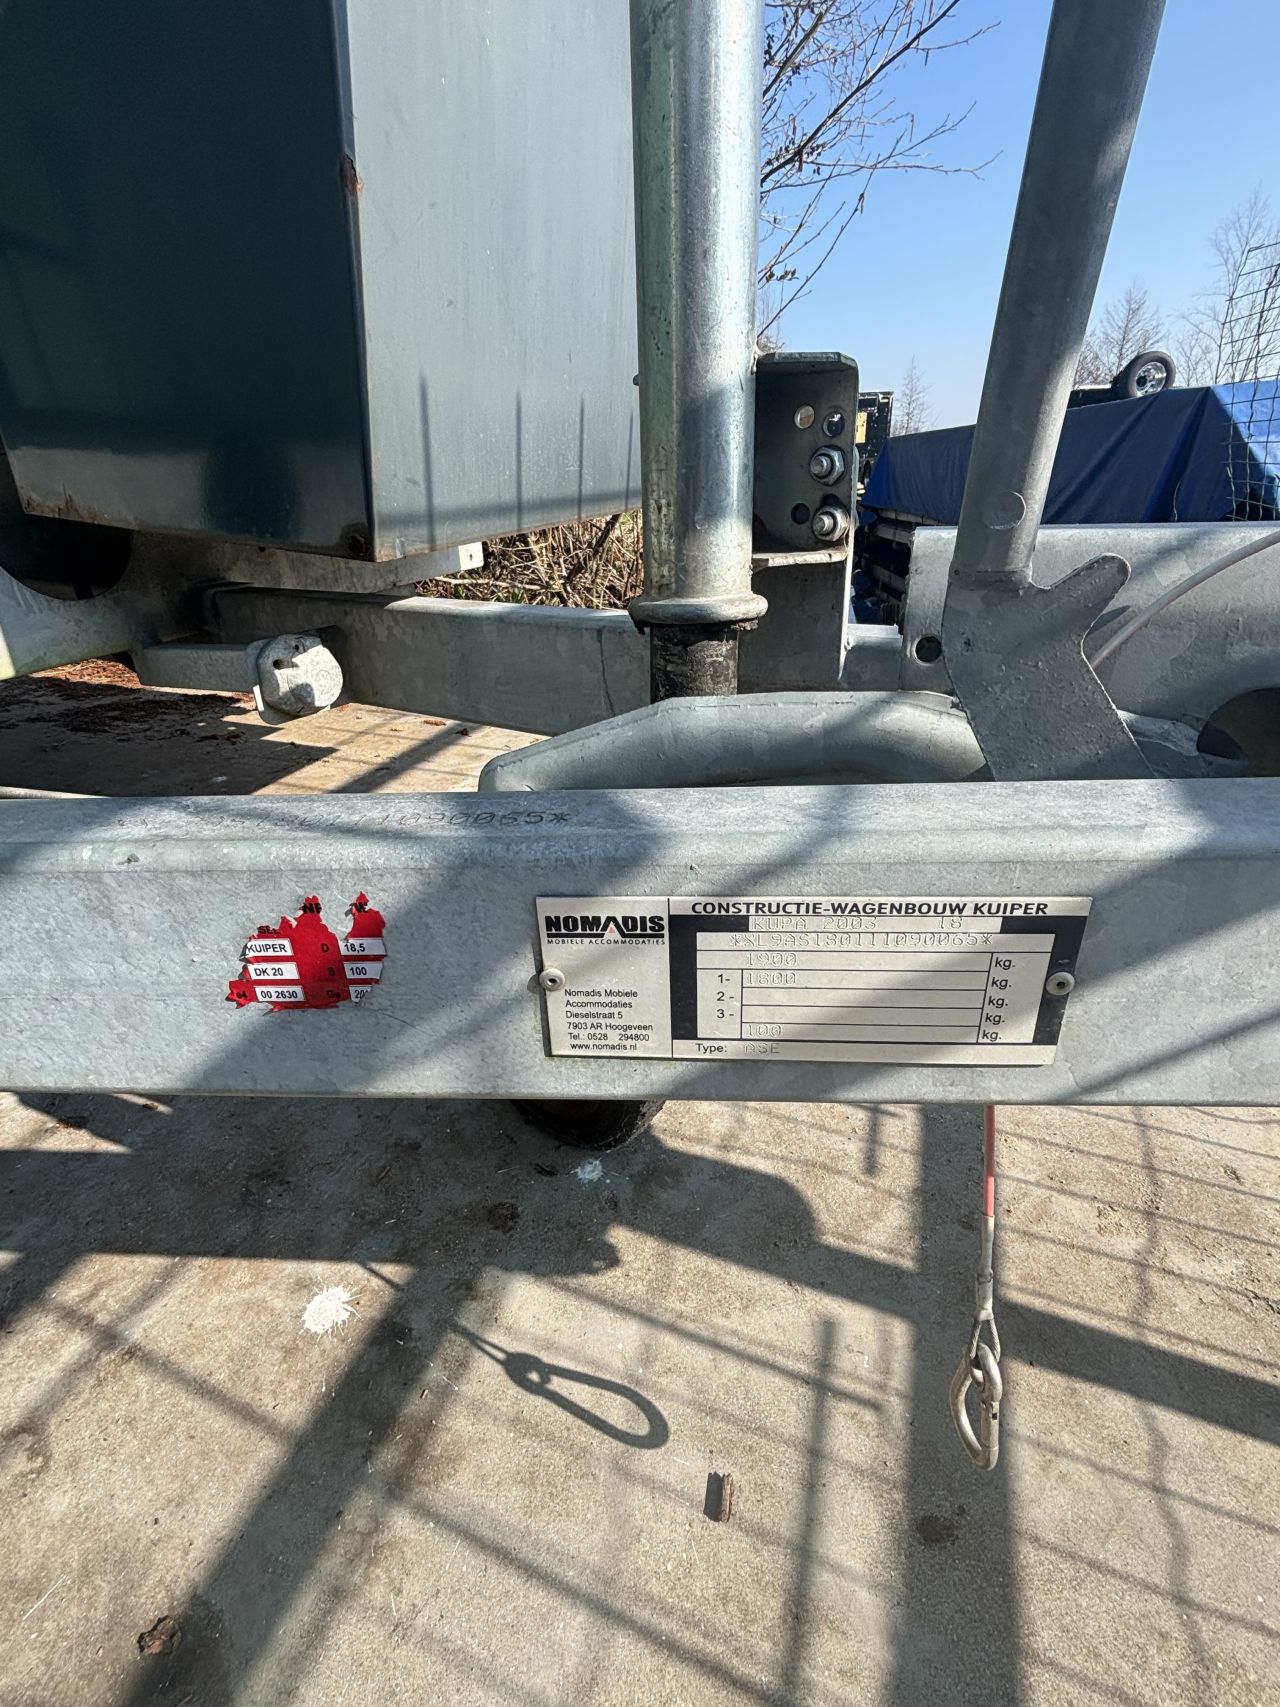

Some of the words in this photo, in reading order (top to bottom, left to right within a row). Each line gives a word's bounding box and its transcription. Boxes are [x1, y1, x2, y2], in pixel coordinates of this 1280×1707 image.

[691, 902, 966, 915] CONSTRUCTIE-WAGENBOUW
[973, 902, 1048, 915] KUIPER
[545, 915, 665, 932] NOMADIS
[823, 916, 877, 931] 2003
[247, 943, 288, 953] KUIPER
[344, 943, 366, 954] 18,5
[994, 957, 1016, 970] kg.
[254, 967, 271, 976] DK
[272, 967, 284, 976] 20
[349, 967, 367, 976] 100
[991, 977, 1012, 990] kg.
[260, 990, 273, 999] 00
[274, 990, 298, 999] 2630
[564, 989, 602, 998] Nomadis
[604, 989, 638, 998] Mobiele
[565, 1000, 633, 1009] Accommodaties
[988, 996, 1009, 1009] kg.
[565, 1011, 616, 1019] Dieselstraat
[984, 1012, 1005, 1025] kg.
[567, 1022, 588, 1030] 7903
[589, 1023, 603, 1031] AR
[605, 1023, 654, 1032] Hoogeveen
[587, 1033, 609, 1041] 0528
[618, 1033, 650, 1042] 294800
[981, 1029, 1002, 1042] kg.
[570, 1042, 638, 1051] www.nomadis.nl
[695, 1043, 728, 1054] Type:
